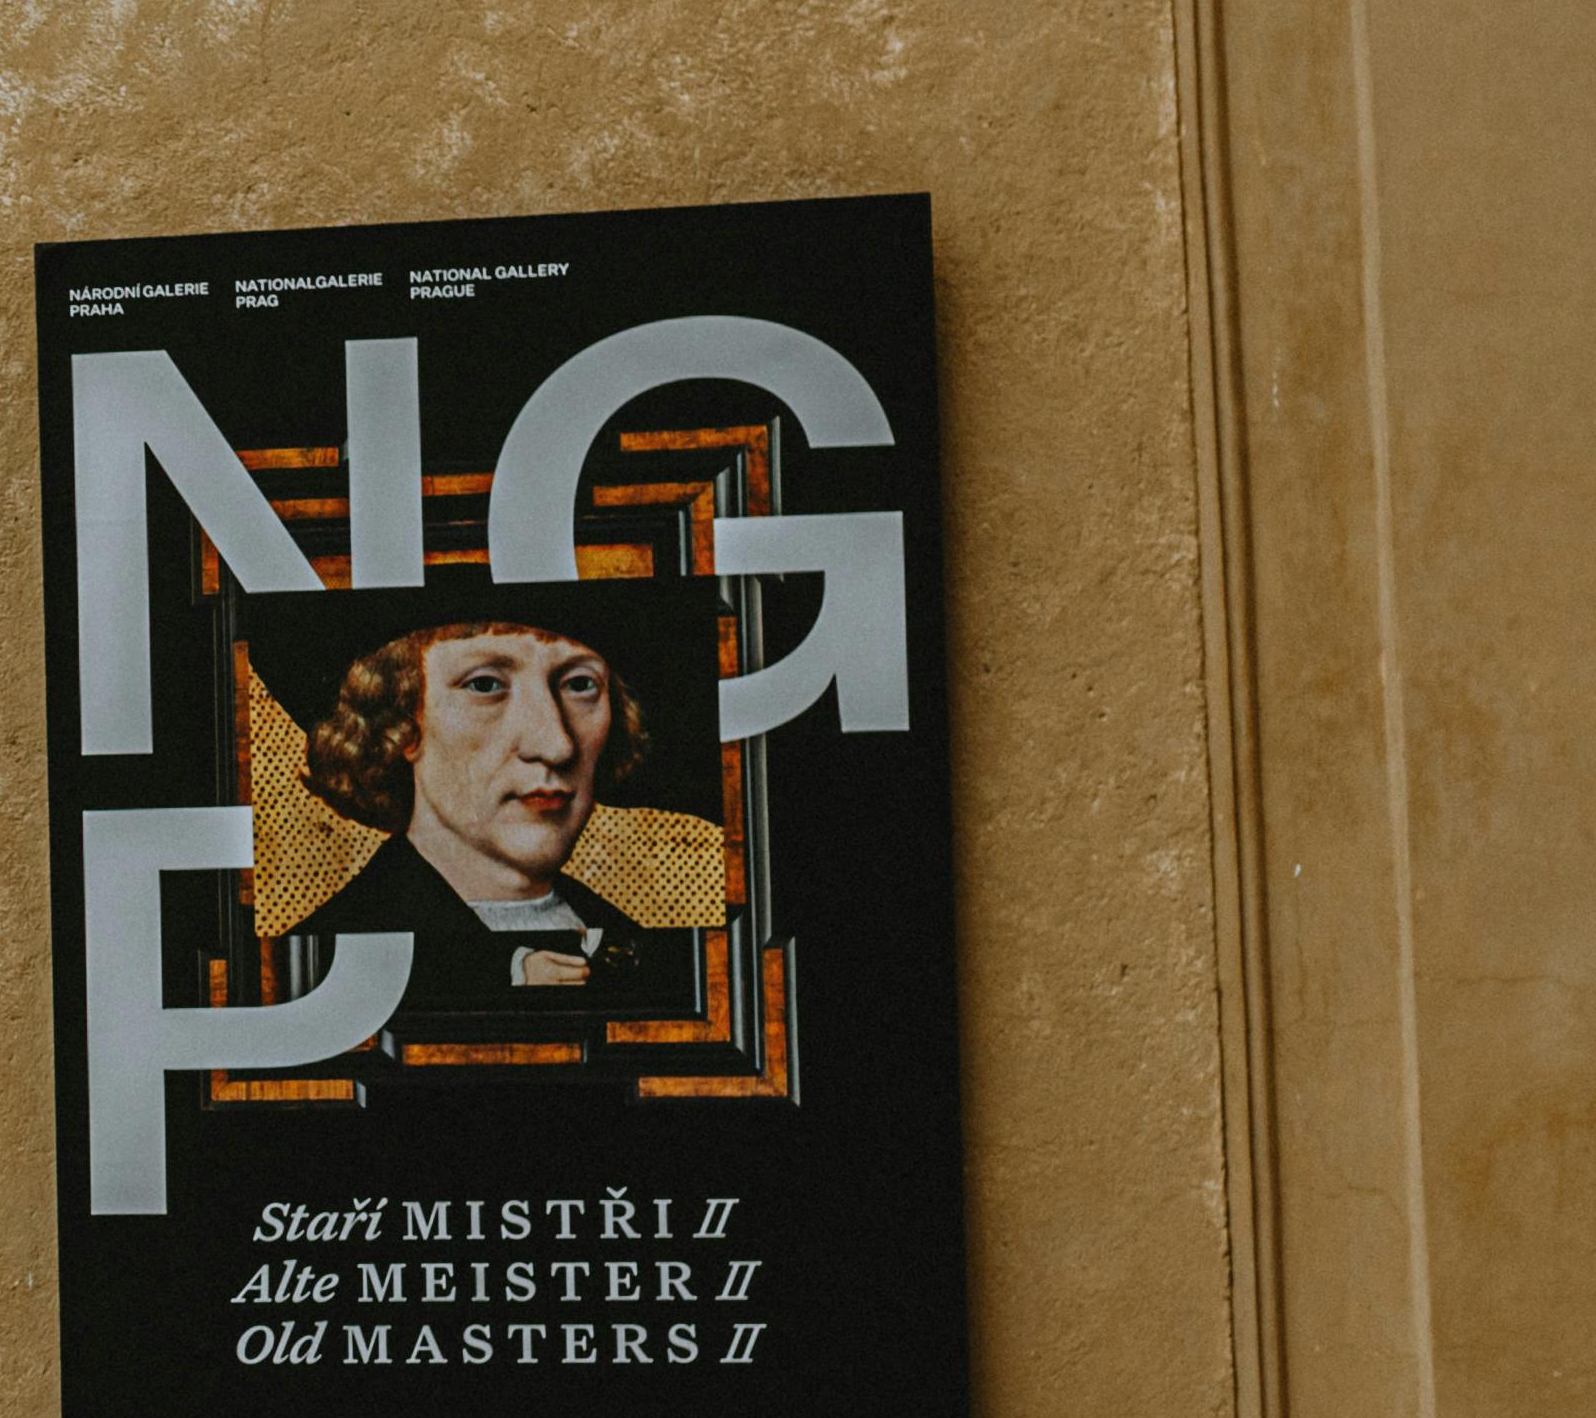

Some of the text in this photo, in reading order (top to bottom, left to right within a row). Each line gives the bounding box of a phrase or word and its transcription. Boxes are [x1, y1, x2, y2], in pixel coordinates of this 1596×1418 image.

[234, 272, 383, 293] NATIONALGALERIE
[409, 262, 570, 284] NATIONAL GALLERY
[68, 281, 210, 302] NÁRODNÍ GALERIE
[235, 293, 280, 309] PRAG
[409, 283, 476, 300] PRAGUE
[69, 302, 125, 318] PRAHA
[252, 1197, 389, 1243] Staří
[401, 1186, 674, 1241] MISTŘI
[230, 1258, 340, 1304] Alte
[356, 1261, 698, 1303] MEISTER
[236, 1320, 329, 1365] Old
[342, 1323, 699, 1365] MASTERS
